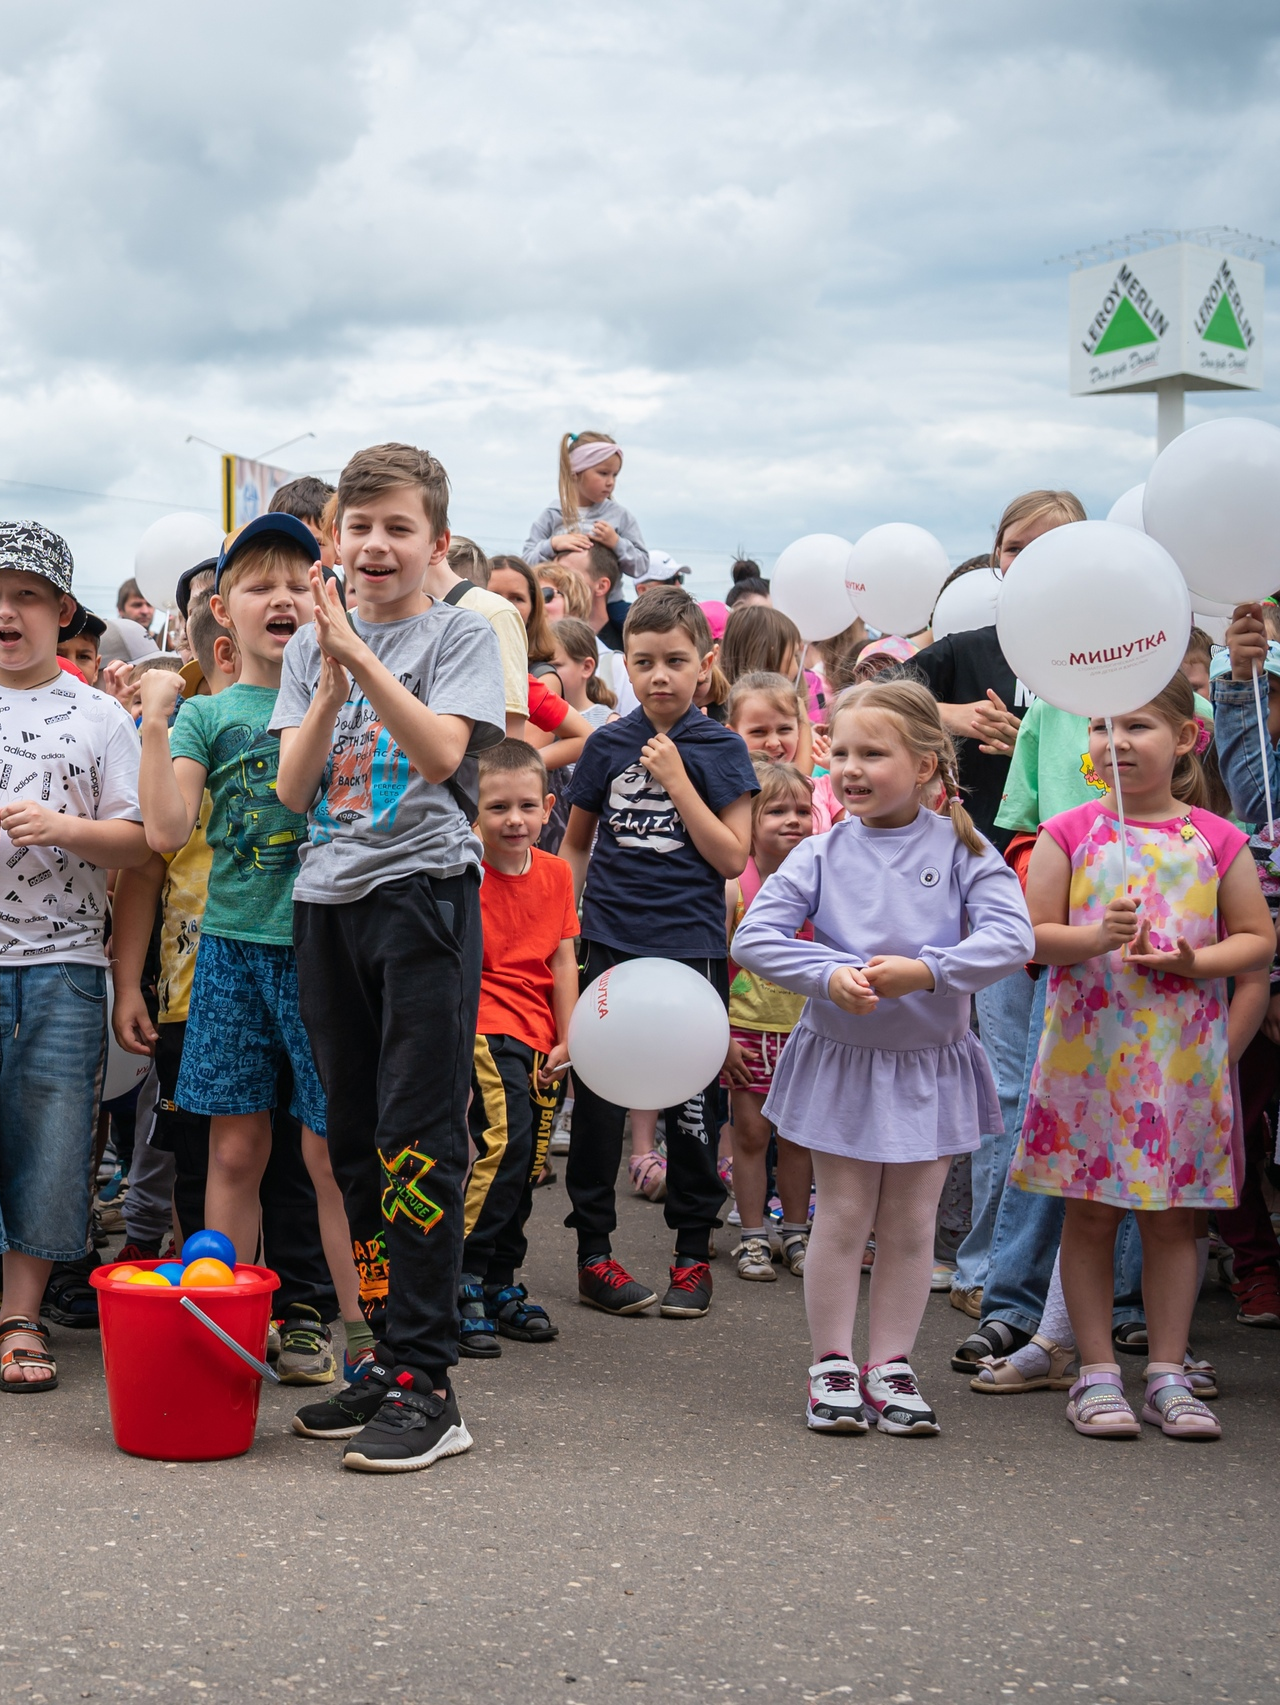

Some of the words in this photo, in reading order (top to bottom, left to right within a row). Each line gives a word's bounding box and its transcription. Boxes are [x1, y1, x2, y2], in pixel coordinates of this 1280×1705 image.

[1081, 282, 1121, 354] LEROY
[1117, 262, 1170, 339] MERLIN
[1193, 273, 1223, 335] LEROY
[1220, 259, 1255, 348] MERLIN
[1069, 630, 1167, 666] МИШУТКА
[4, 745, 37, 760] adidas
[41, 752, 65, 760] adidas
[13, 771, 38, 793] adidas
[338, 775, 361, 787] BACK
[339, 812, 359, 822] 1985
[28, 869, 52, 887] adidas
[25, 915, 48, 923] adidas
[23, 944, 56, 956] adidas
[531, 1109, 554, 1176] BATMAN
